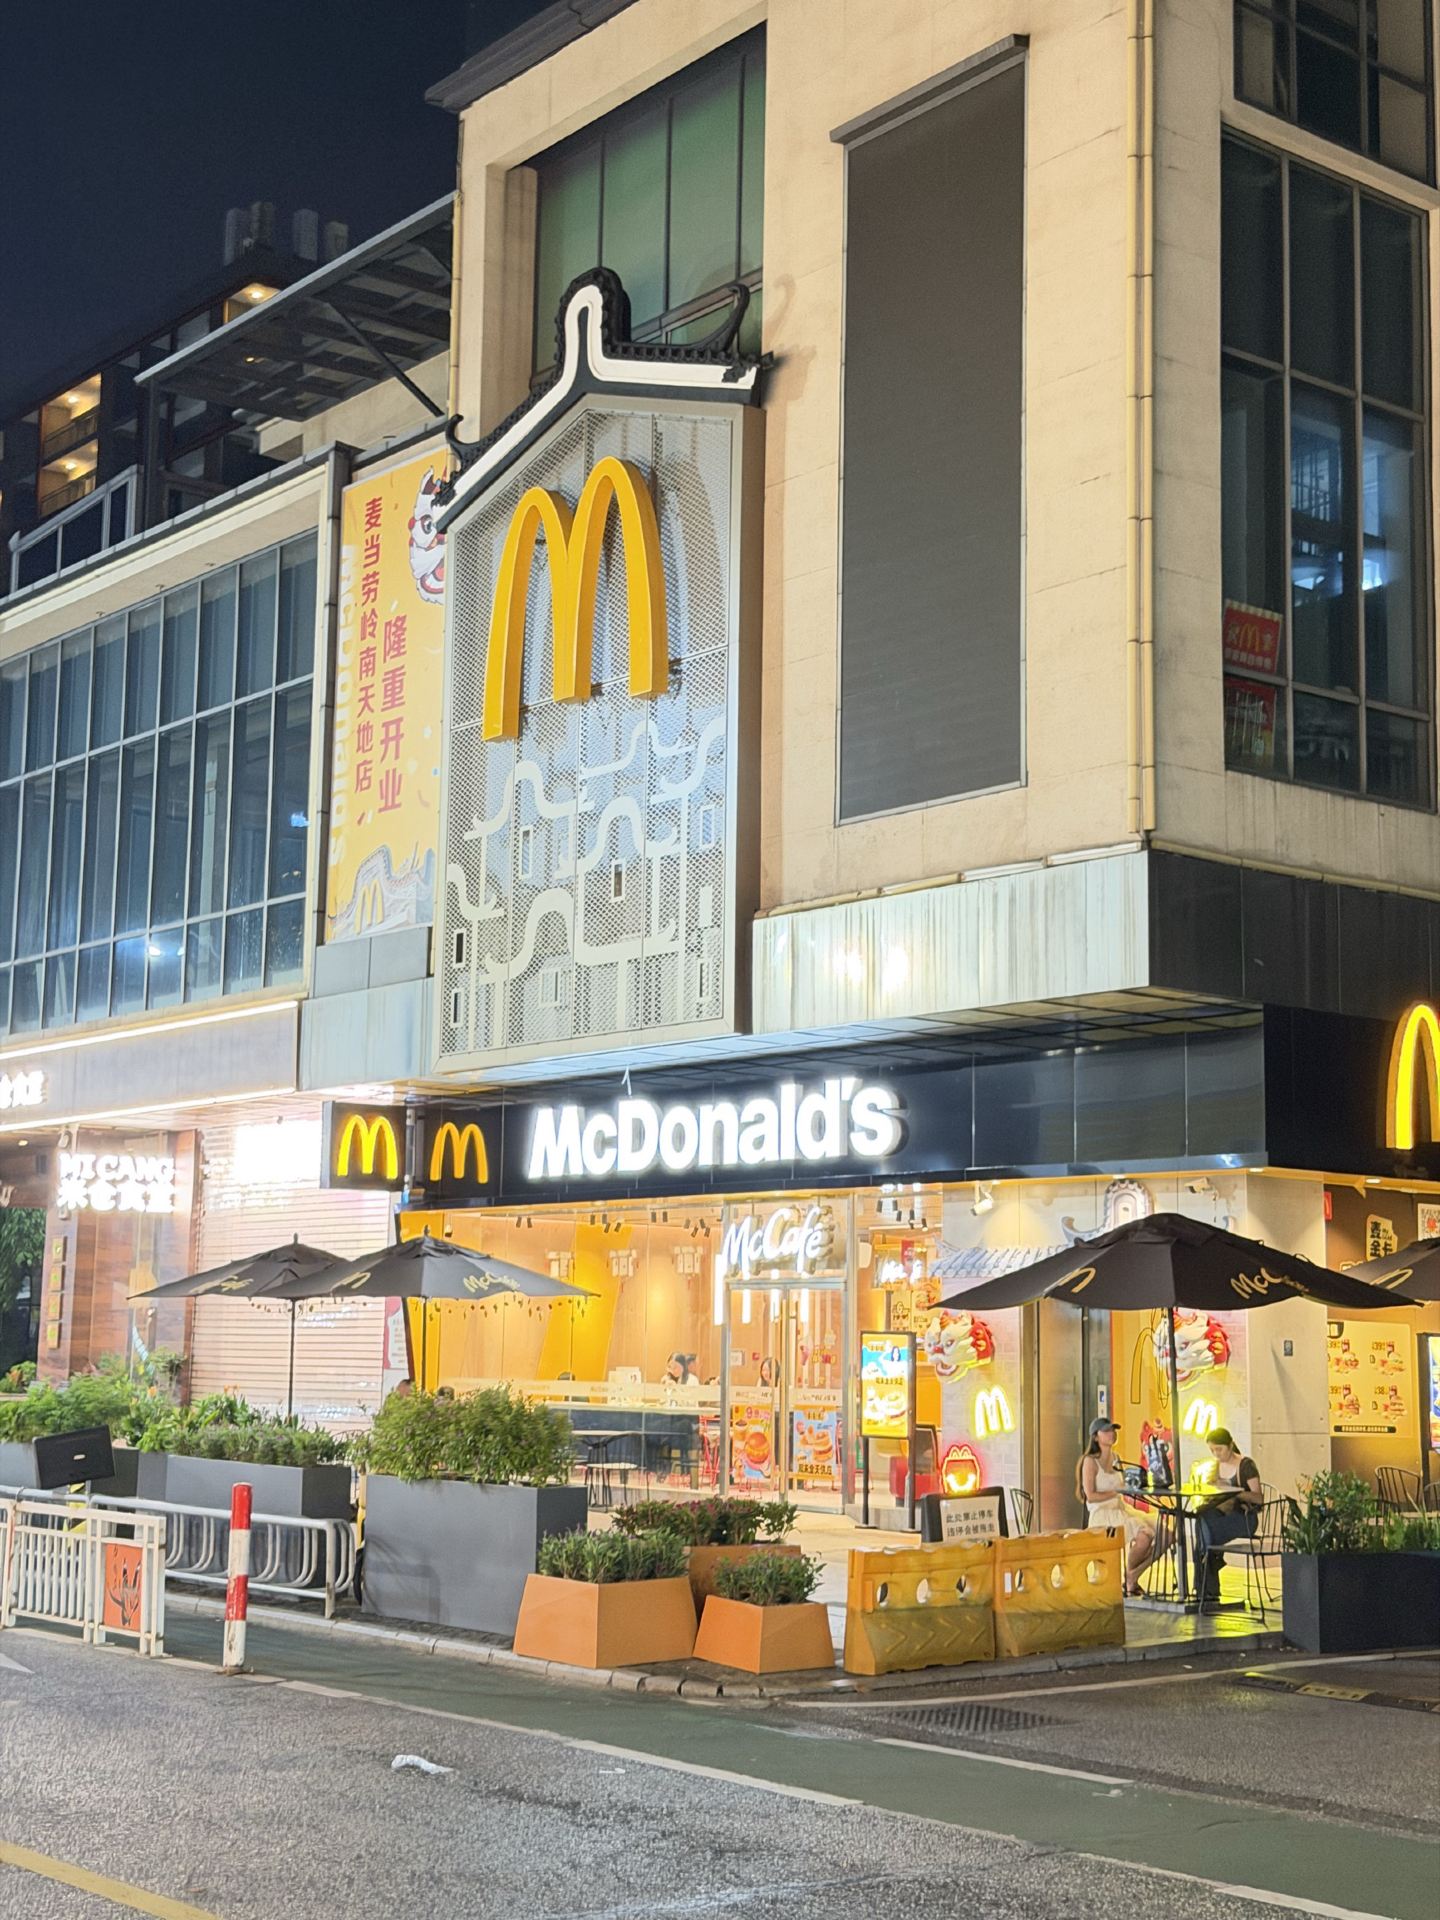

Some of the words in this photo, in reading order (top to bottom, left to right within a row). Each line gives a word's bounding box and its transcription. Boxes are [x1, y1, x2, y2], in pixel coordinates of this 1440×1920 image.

[355, 496, 382, 793] 麦当劳岭南天地店
[377, 614, 407, 813] 隆重开业
[528, 1077, 900, 1179] McDonald's
[720, 1206, 823, 1280] McCafé
